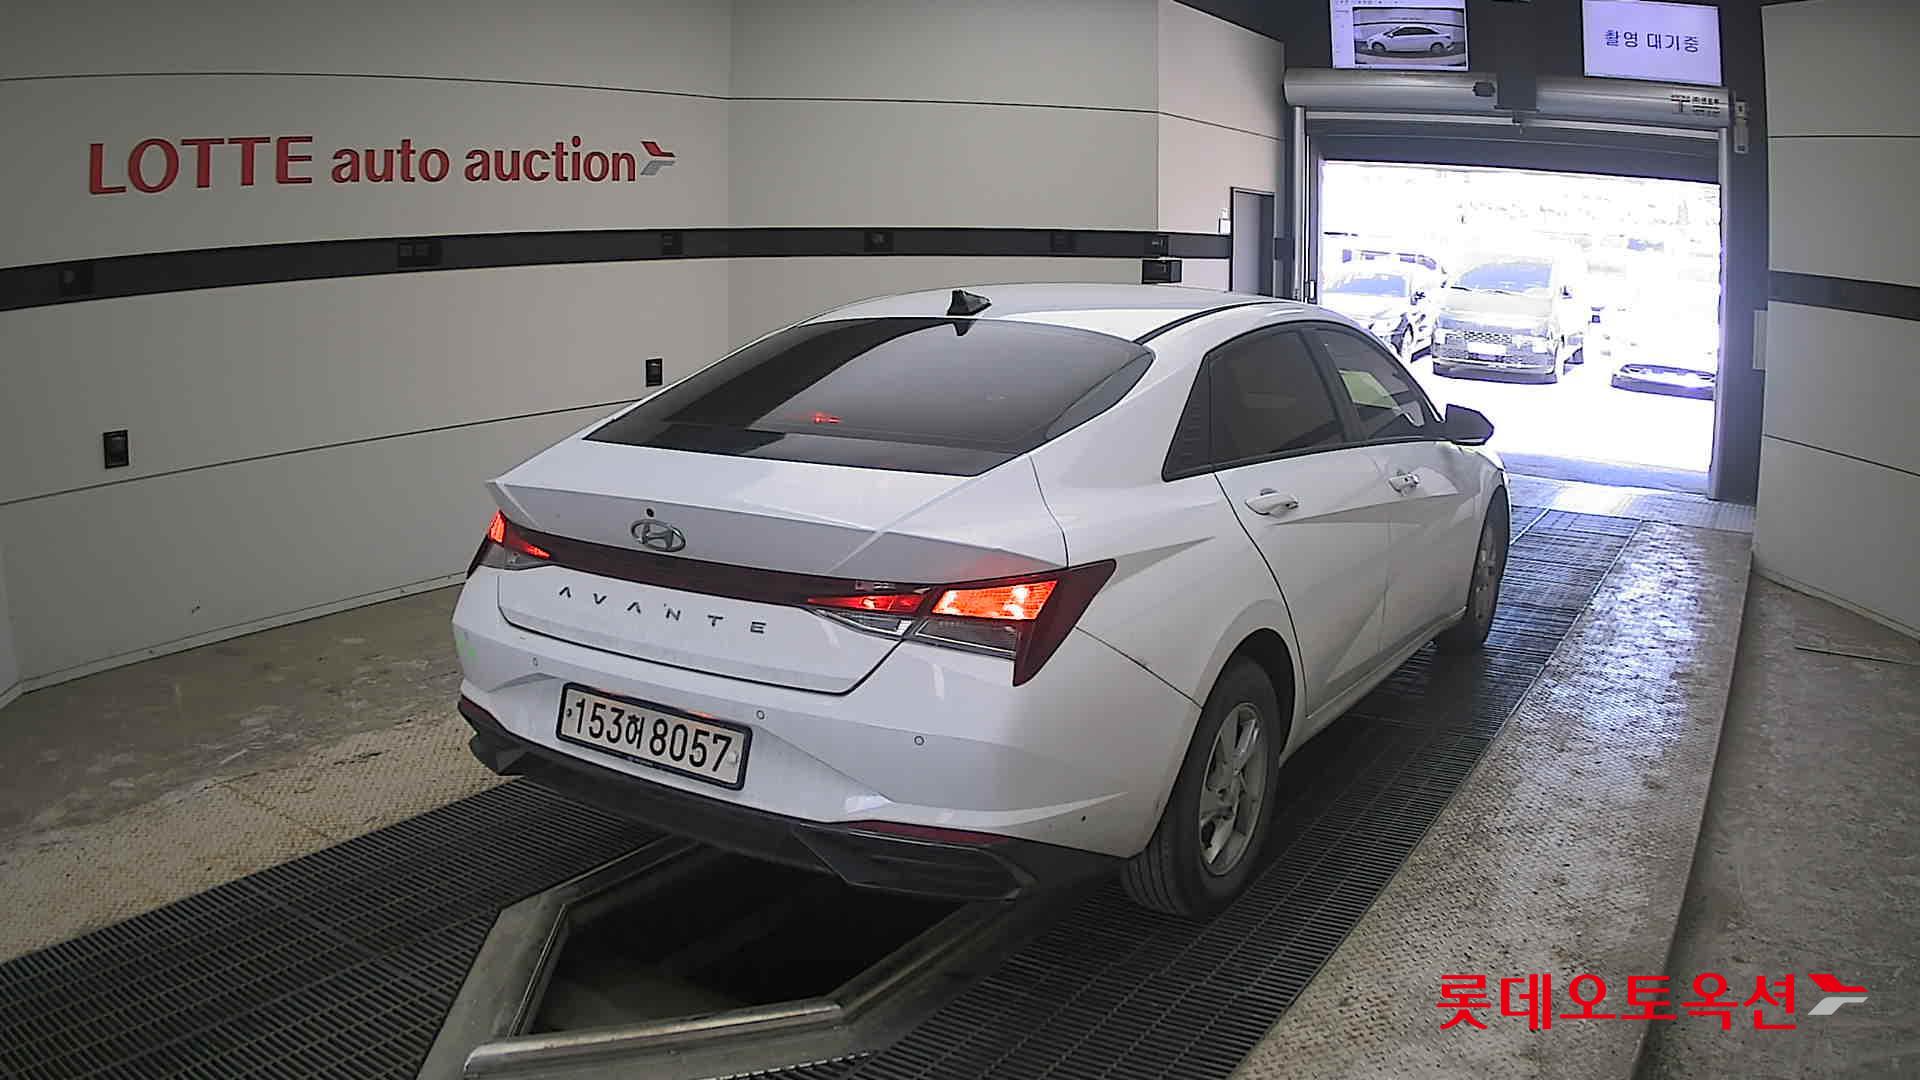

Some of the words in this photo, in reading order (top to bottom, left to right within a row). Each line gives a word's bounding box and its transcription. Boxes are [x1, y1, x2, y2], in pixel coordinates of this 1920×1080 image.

[1646, 32, 1699, 53] 대기중
[89, 135, 314, 196] LOTTE
[331, 138, 450, 184] auto
[463, 135, 637, 182] auction
[558, 585, 767, 635] AVANTE
